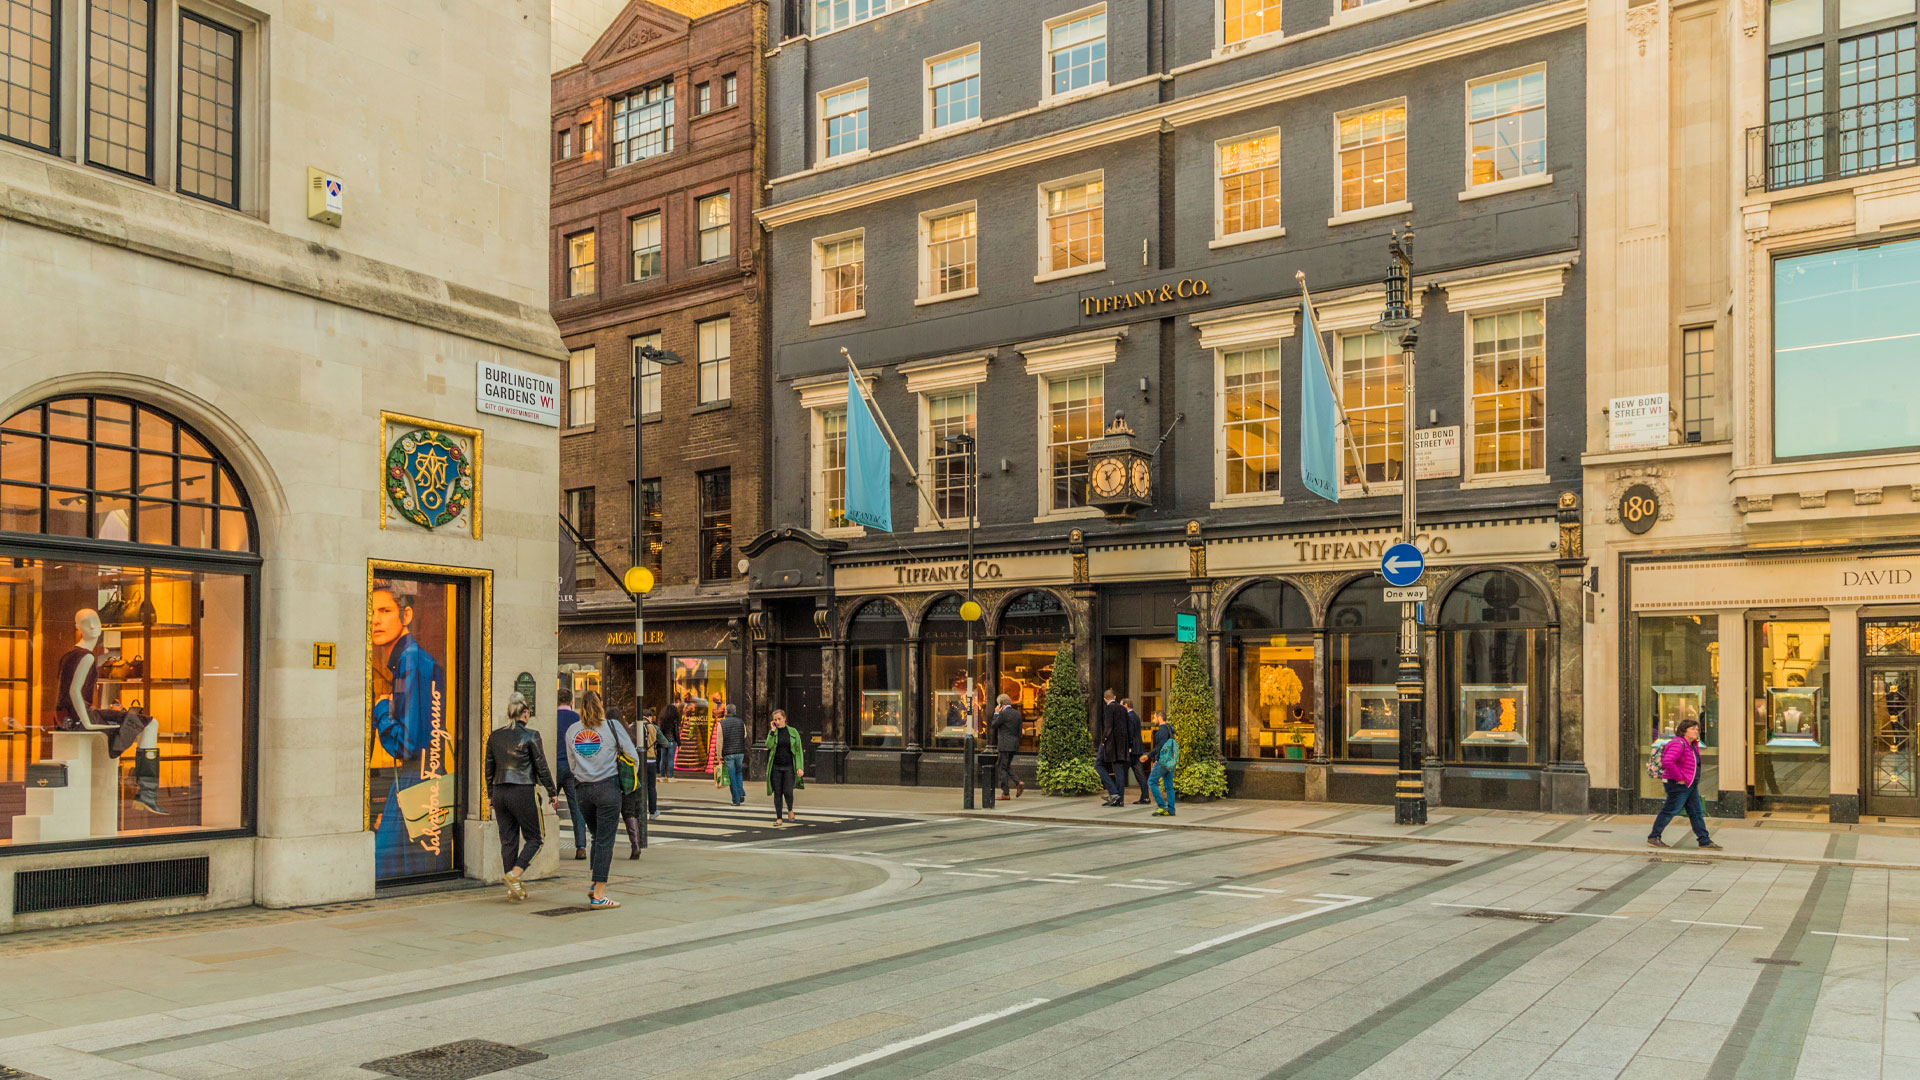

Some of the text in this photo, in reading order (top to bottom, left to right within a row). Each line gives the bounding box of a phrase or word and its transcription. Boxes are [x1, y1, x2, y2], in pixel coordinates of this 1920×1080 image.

[1080, 287, 1159, 316] TIFFANY
[485, 367, 553, 395] BURLINGTON
[485, 383, 554, 410] GARDENS W1
[1614, 396, 1663, 409] NEW BOND
[484, 402, 496, 410] CITY
[505, 407, 540, 420] WESTMINSTER
[1614, 406, 1662, 419] STREET W1
[1415, 429, 1454, 441] OLD BOND
[1415, 438, 1455, 449] STREET W1
[1623, 495, 1655, 522] 180
[1293, 540, 1387, 563] TIFFANY
[894, 565, 959, 584] TIFFANY
[1843, 569, 1912, 587] DAVID
[1385, 590, 1424, 599] One way
[607, 631, 664, 645] MONLER
[420, 680, 451, 857] Salvatore Ferragamo
